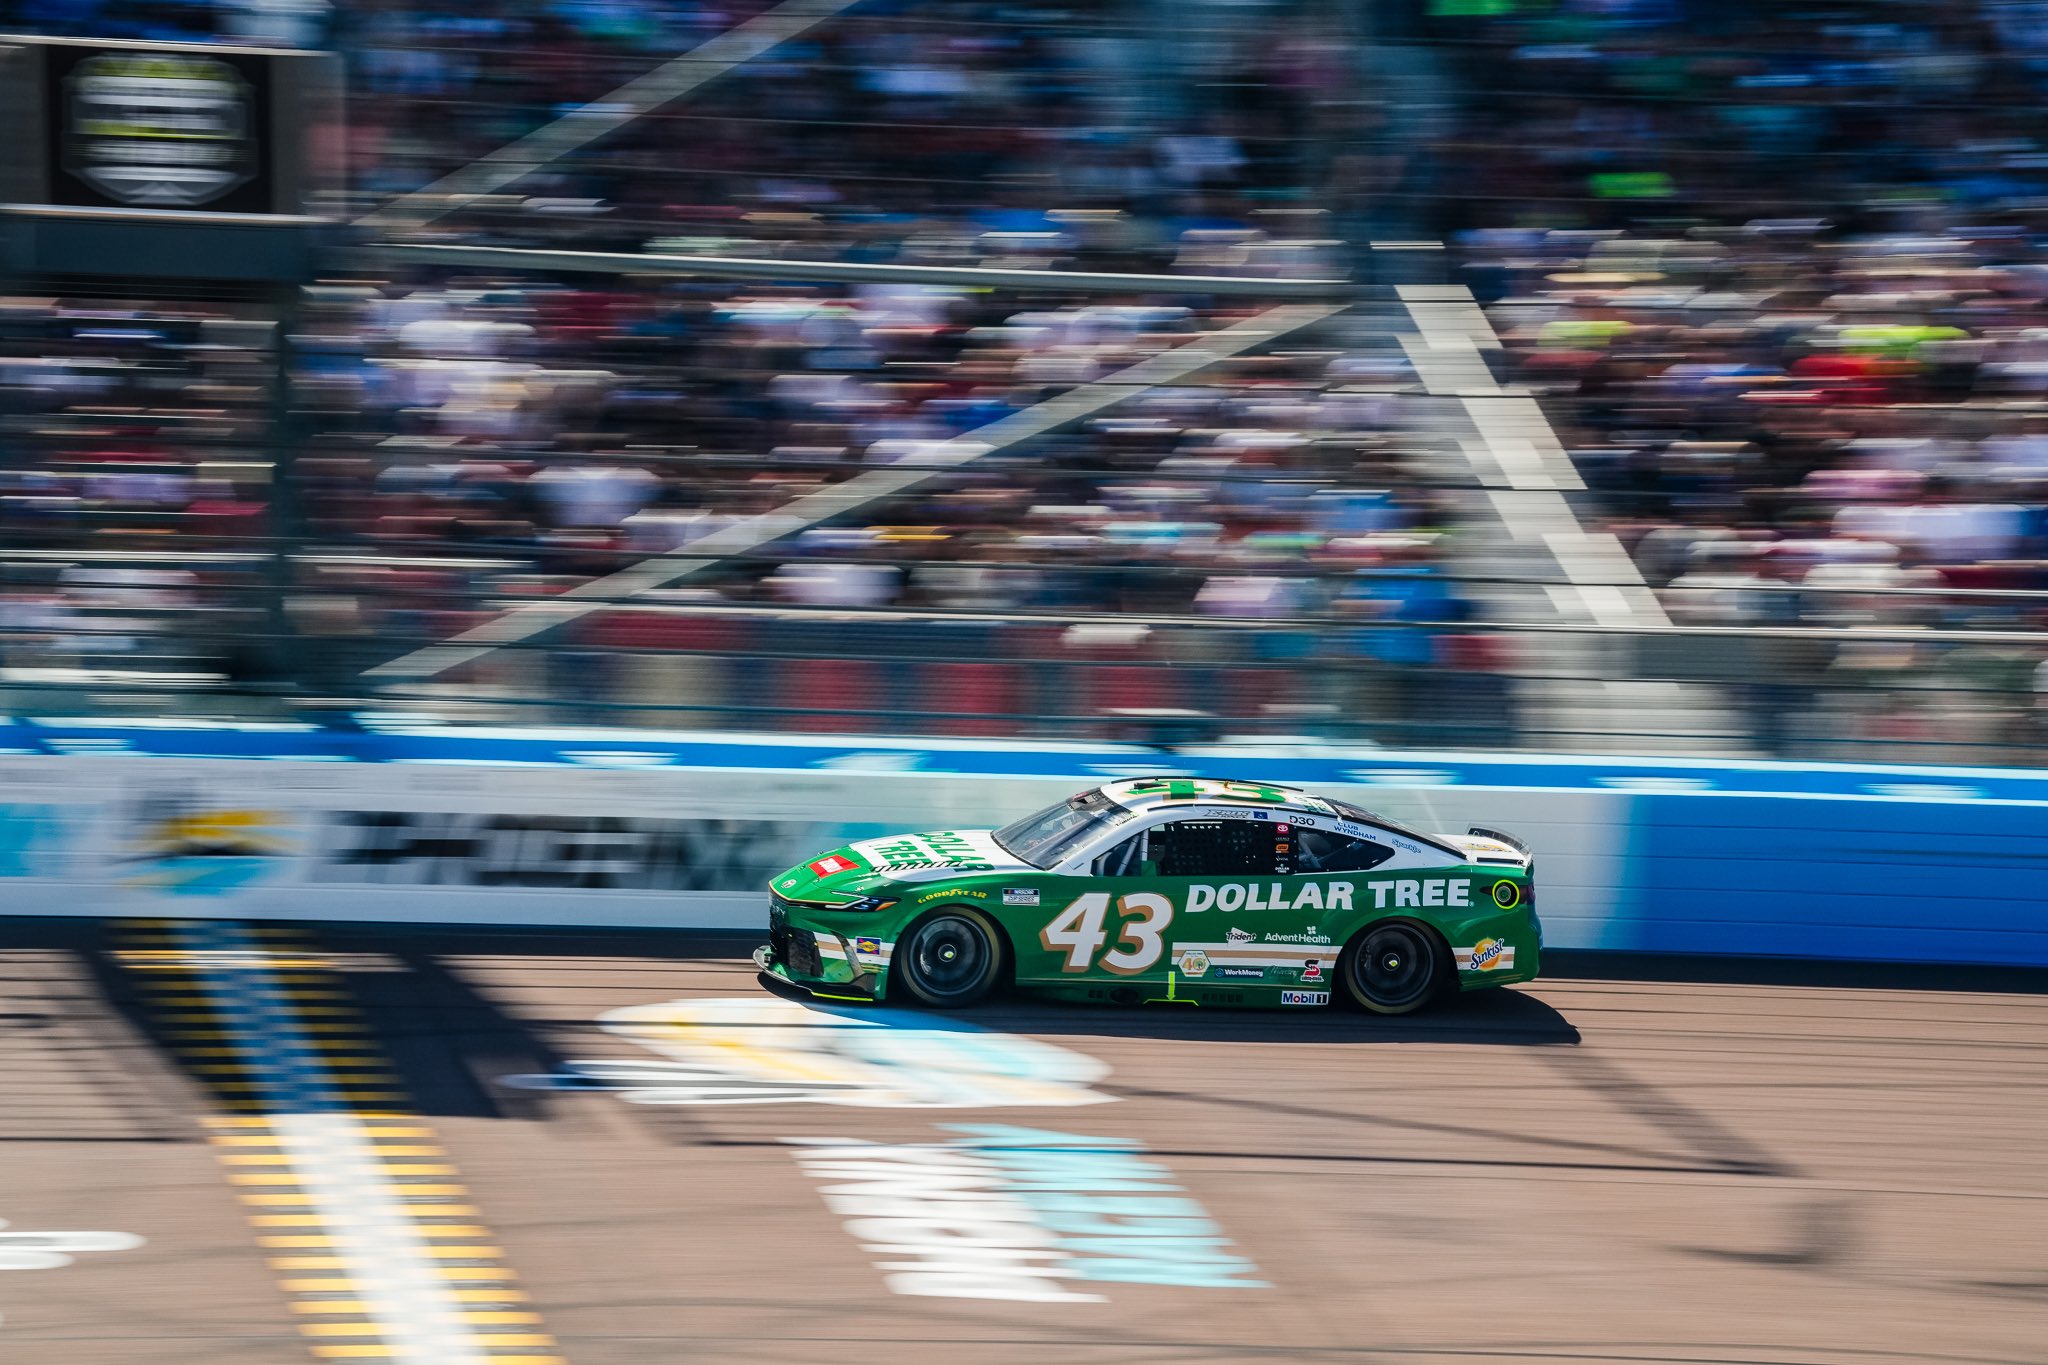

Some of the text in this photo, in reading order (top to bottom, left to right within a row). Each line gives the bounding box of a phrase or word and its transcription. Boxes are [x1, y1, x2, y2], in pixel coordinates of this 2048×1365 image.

[1333, 825, 1377, 841] WYNDHAM
[1337, 822, 1359, 831] CLUB
[913, 831, 996, 873] DOLLAR
[1185, 879, 1471, 912] DOLLAR TREE
[1039, 892, 1175, 976] 43
[1226, 932, 1257, 942] Trident
[1470, 938, 1505, 971] Sunkist
[1224, 969, 1264, 978] WorkMoney
[1282, 992, 1328, 1004] Mobil 1
